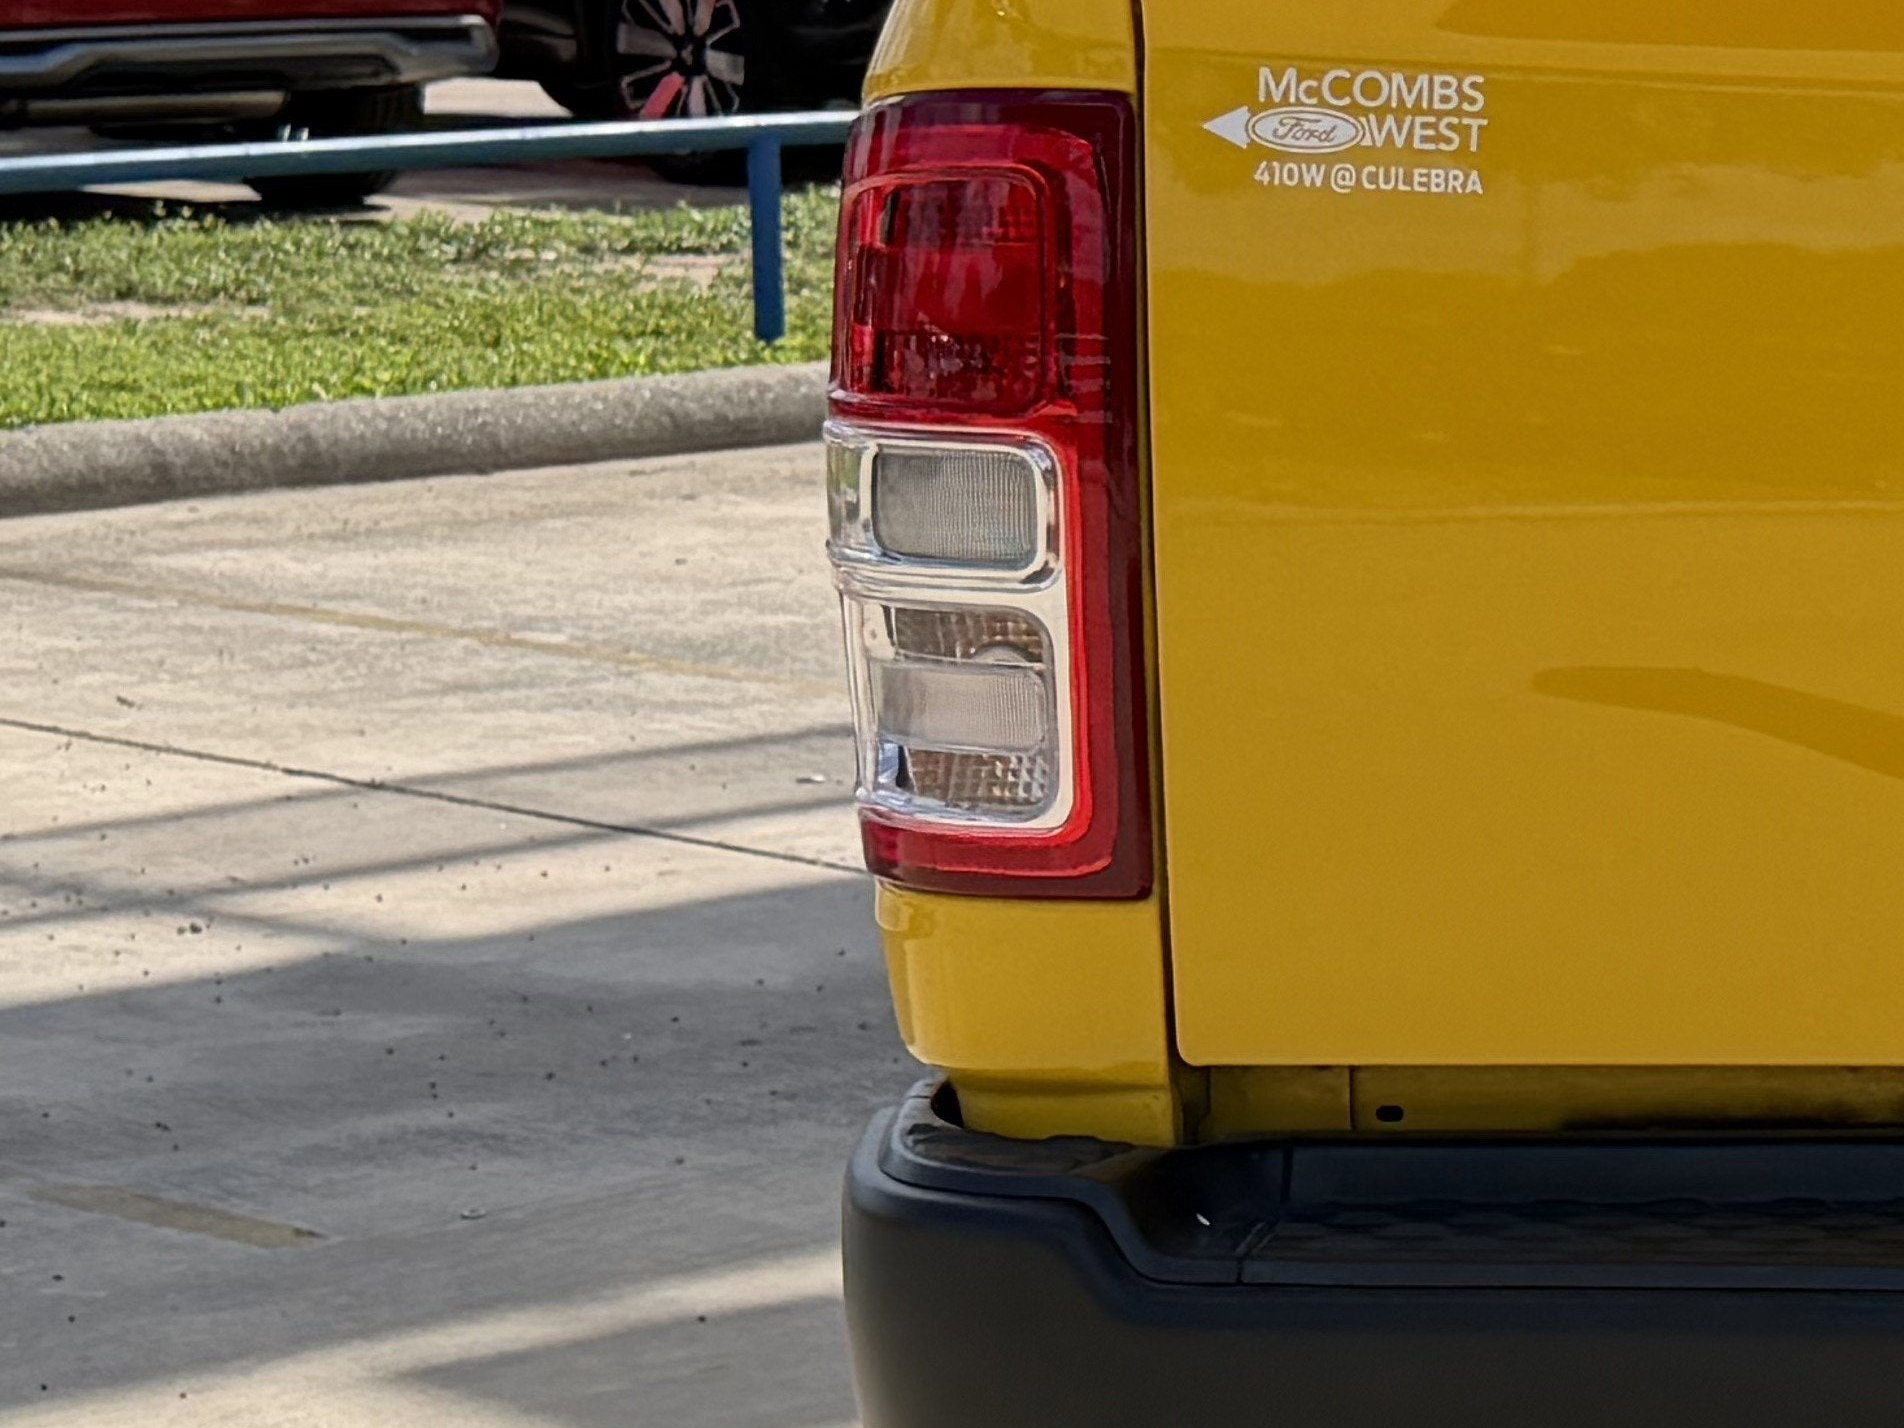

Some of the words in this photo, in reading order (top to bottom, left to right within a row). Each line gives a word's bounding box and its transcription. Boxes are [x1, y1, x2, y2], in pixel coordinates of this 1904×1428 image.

[1258, 66, 1486, 112] McCOMBS
[1272, 116, 1338, 143] Ford
[1367, 113, 1488, 153] WEST
[1361, 165, 1485, 195] CULEBRA
